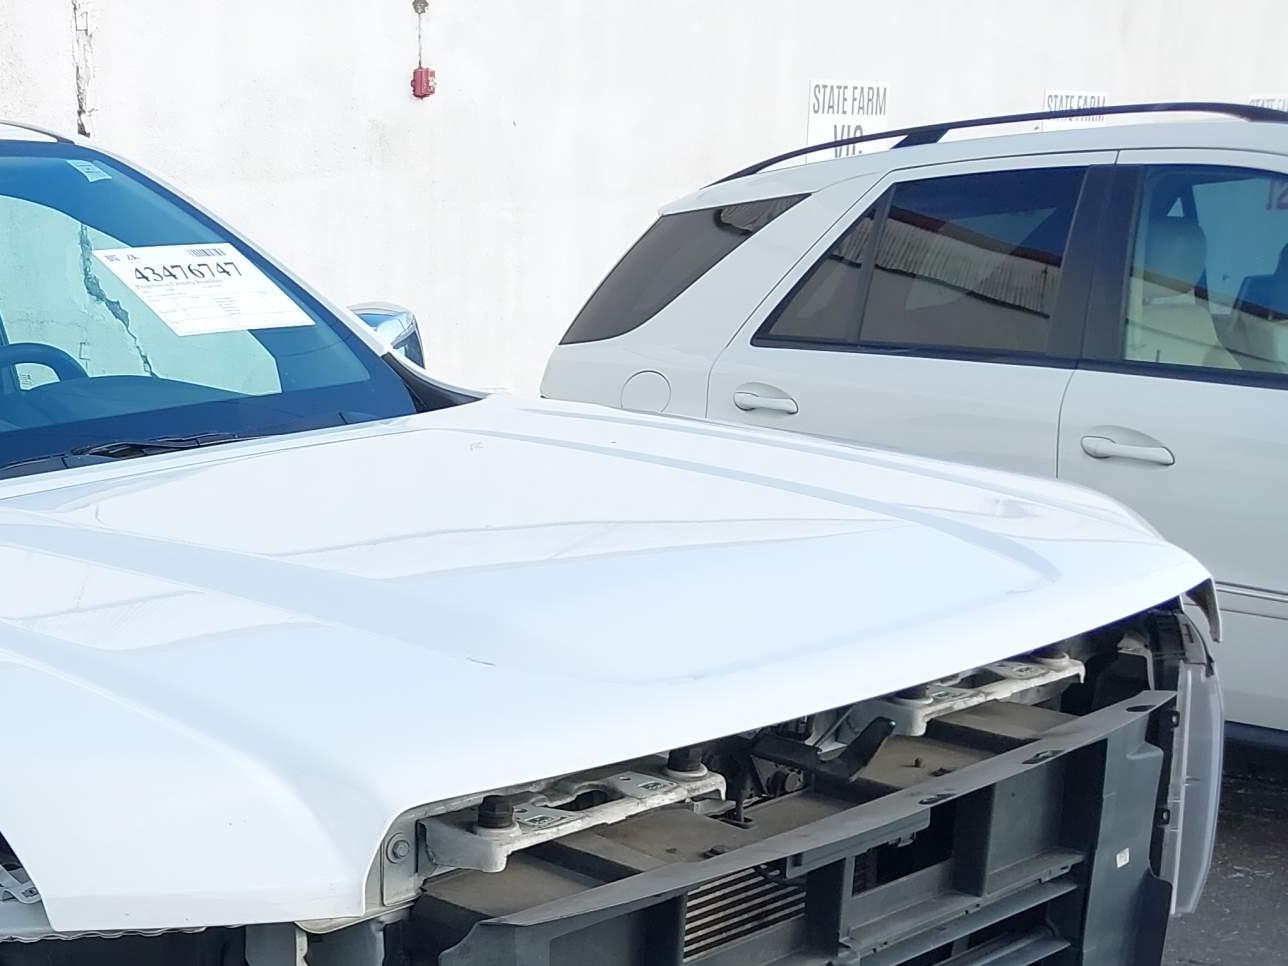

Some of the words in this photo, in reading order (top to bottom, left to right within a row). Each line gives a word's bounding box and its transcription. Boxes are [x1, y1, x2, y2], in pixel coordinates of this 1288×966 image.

[812, 83, 849, 115] STATE
[850, 85, 887, 116] FARM
[134, 261, 243, 282] 43476747
